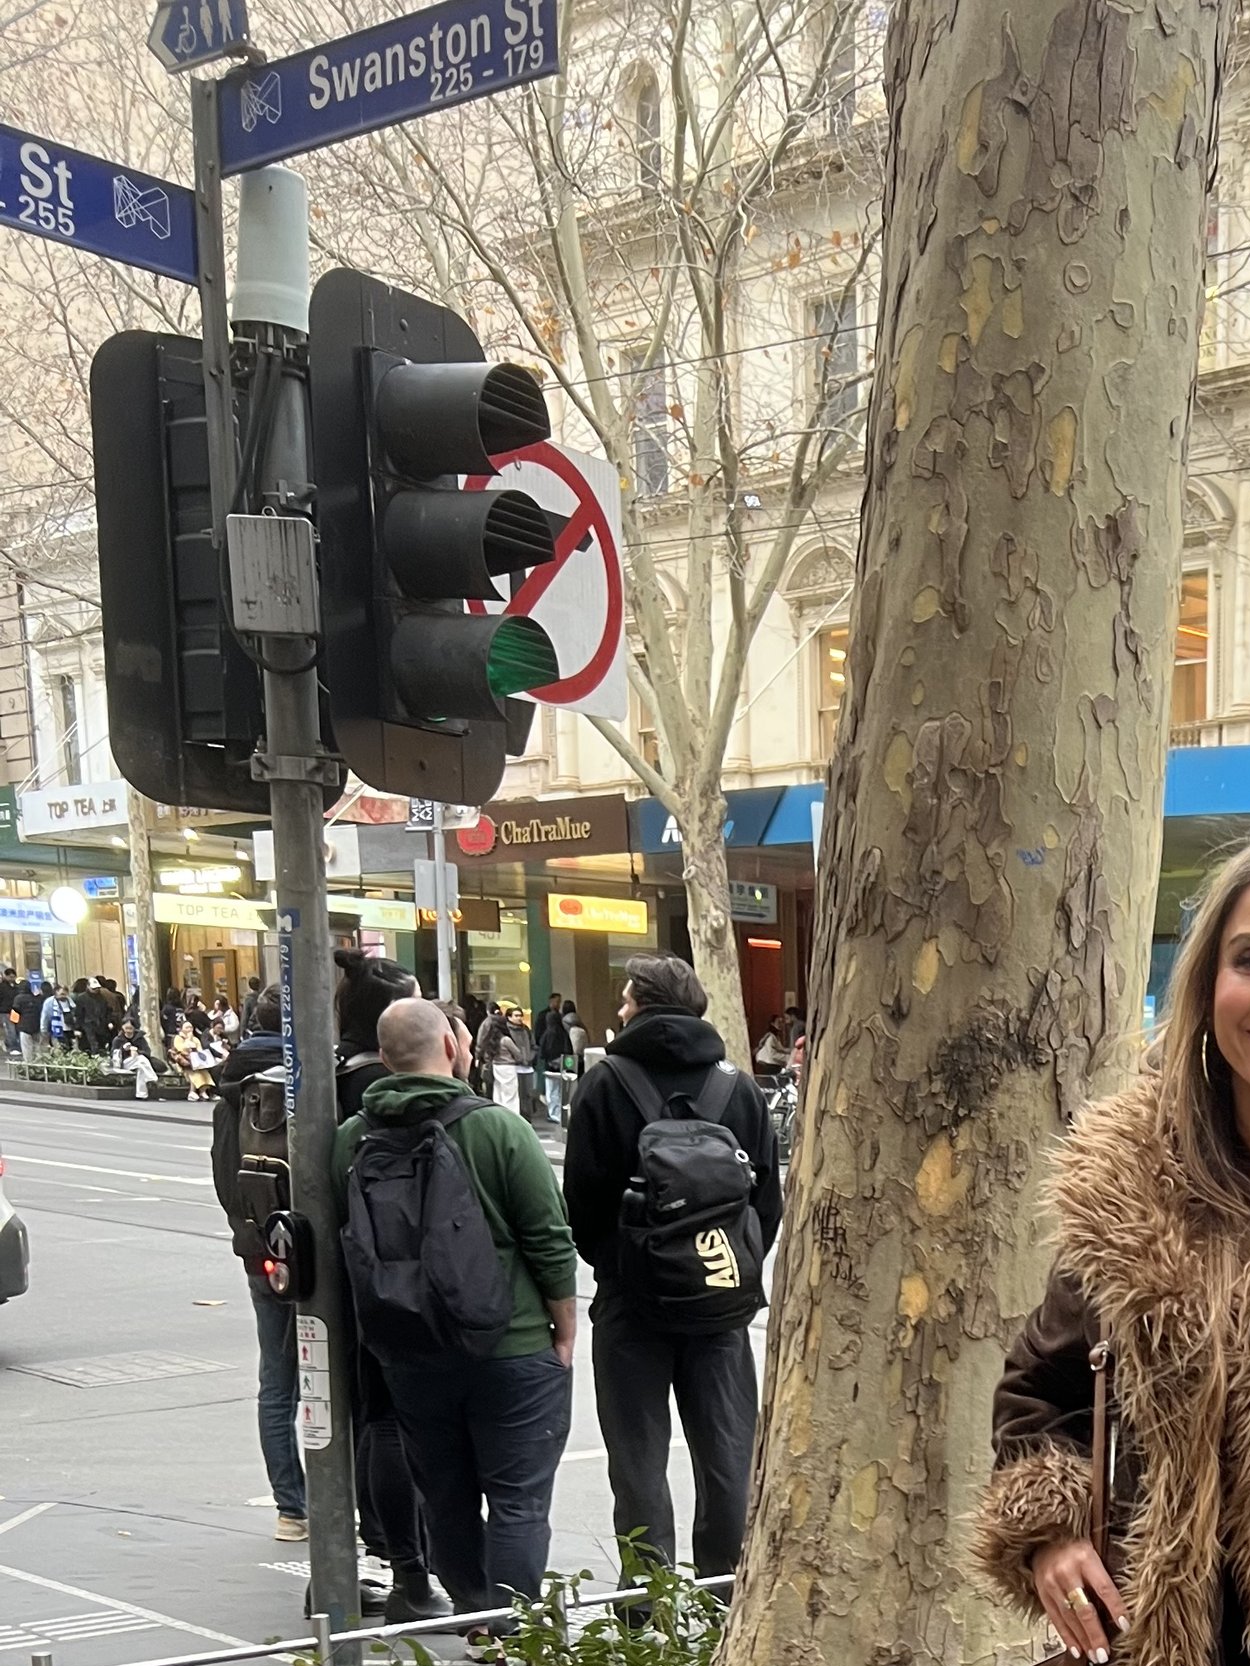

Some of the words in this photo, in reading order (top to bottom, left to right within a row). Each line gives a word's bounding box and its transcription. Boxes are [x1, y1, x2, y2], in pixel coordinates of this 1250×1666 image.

[308, 14, 493, 110] Swanston
[503, 0, 545, 46] St
[430, 69, 474, 101] 225
[505, 40, 545, 76] 179
[20, 142, 74, 209] St
[18, 195, 76, 237] 255
[47, 800, 69, 820] TOP
[74, 798, 97, 816] TEA
[500, 816, 591, 845] ChaTraMue
[177, 903, 204, 917] TOP
[211, 905, 239, 918] TEA
